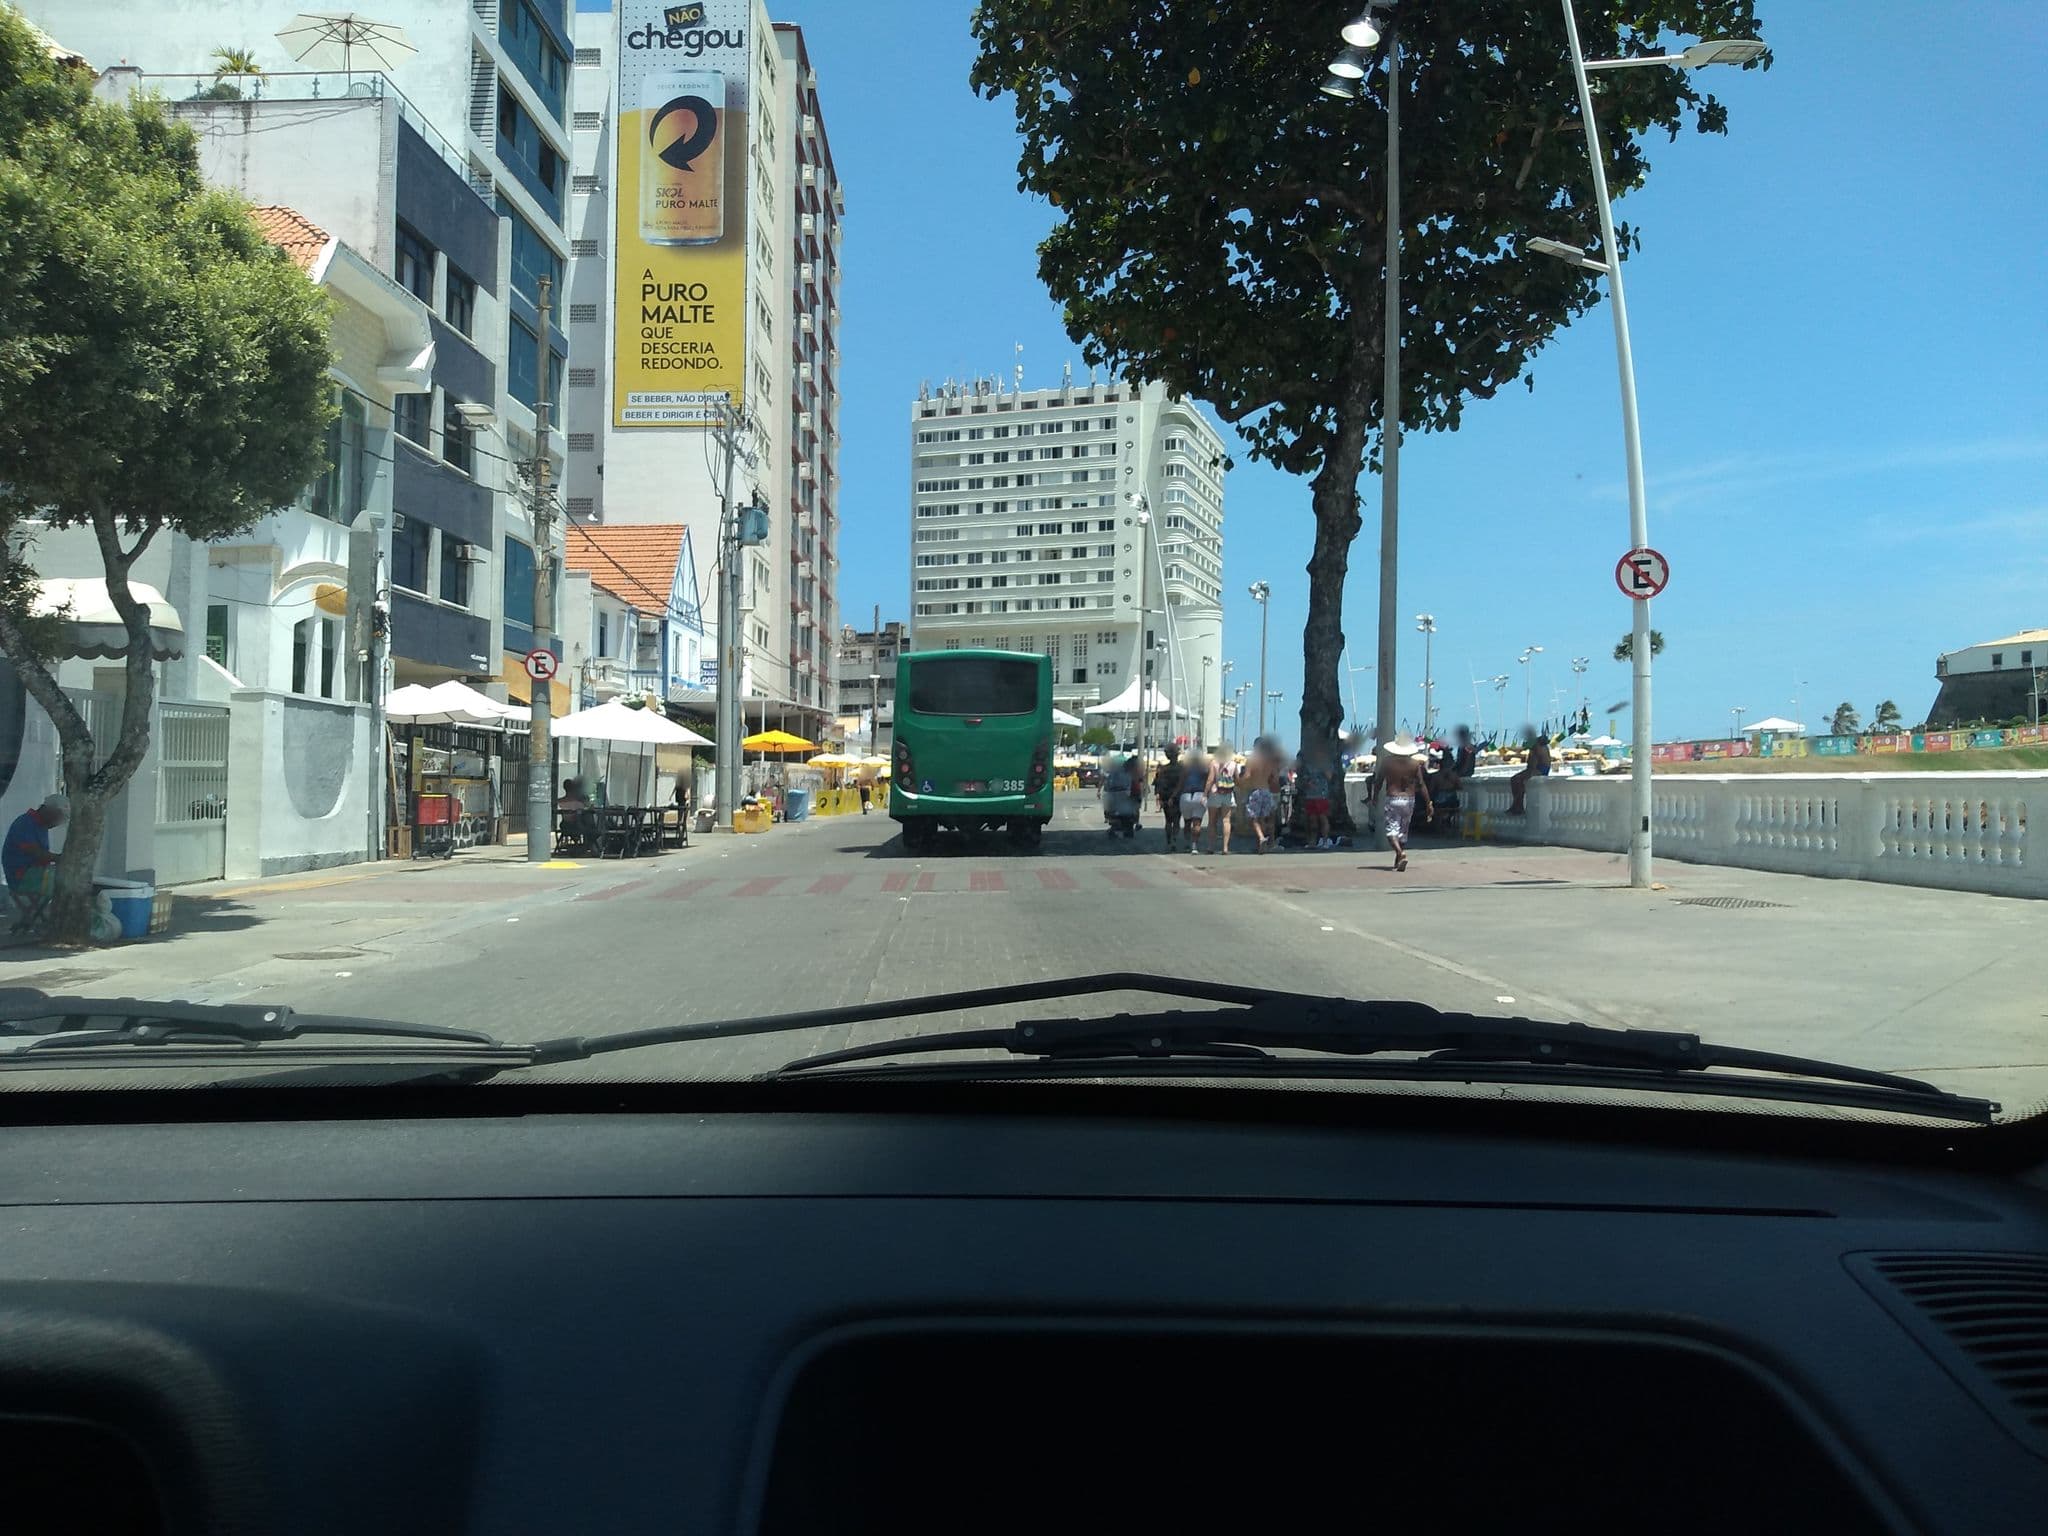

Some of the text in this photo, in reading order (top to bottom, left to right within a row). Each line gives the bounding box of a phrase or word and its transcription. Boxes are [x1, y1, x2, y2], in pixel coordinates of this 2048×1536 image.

[668, 8, 700, 25] NÃO
[627, 23, 743, 57] chegou
[656, 187, 683, 198] SKOL
[656, 199, 718, 208] PURO MALTE
[643, 268, 653, 280] A
[642, 283, 707, 301] PURO
[642, 305, 714, 323] MALTE
[641, 327, 673, 339] QUE
[641, 342, 715, 354] DESCERIA
[641, 357, 723, 369] REDONDO.
[645, 395, 674, 403] BEBER,
[676, 394, 695, 402] NÃO
[696, 410, 702, 418] É
